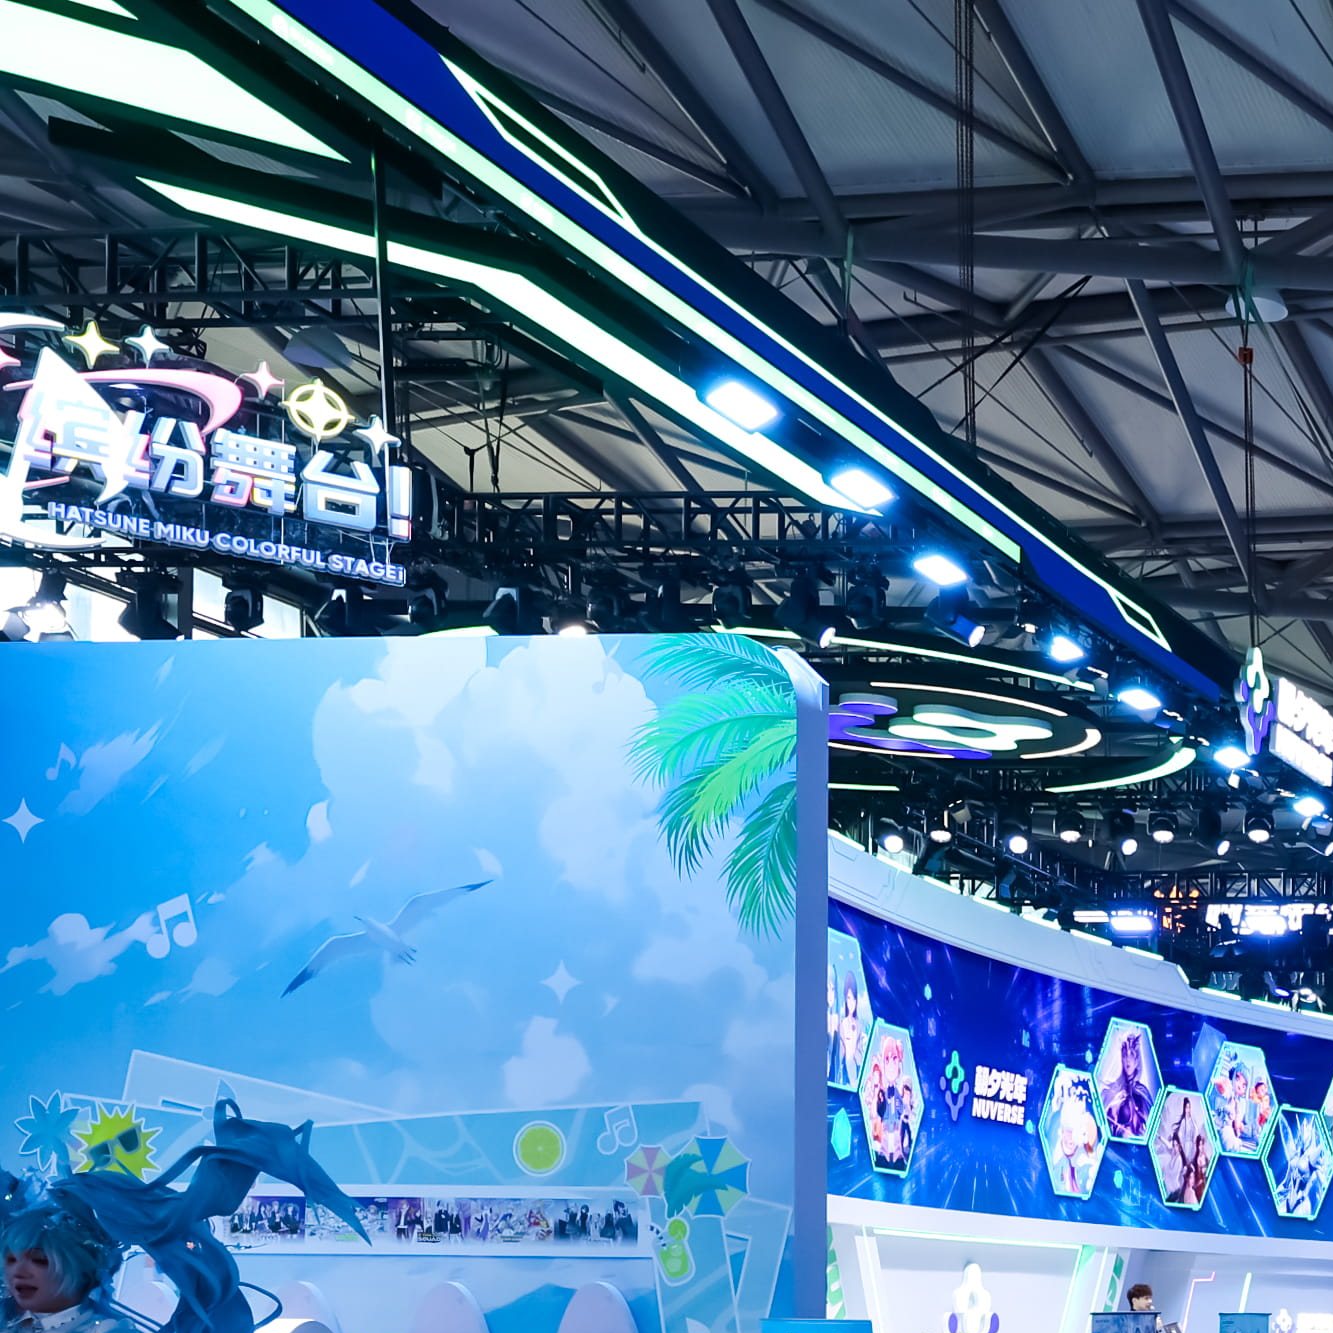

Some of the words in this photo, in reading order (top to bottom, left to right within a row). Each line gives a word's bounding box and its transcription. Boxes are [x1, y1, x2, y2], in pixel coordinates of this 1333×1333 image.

[48, 501, 151, 535] HATSUNE
[156, 522, 210, 545] MIKU
[211, 532, 325, 568] COLORFUL
[972, 1097, 1025, 1126] NUVERSE
